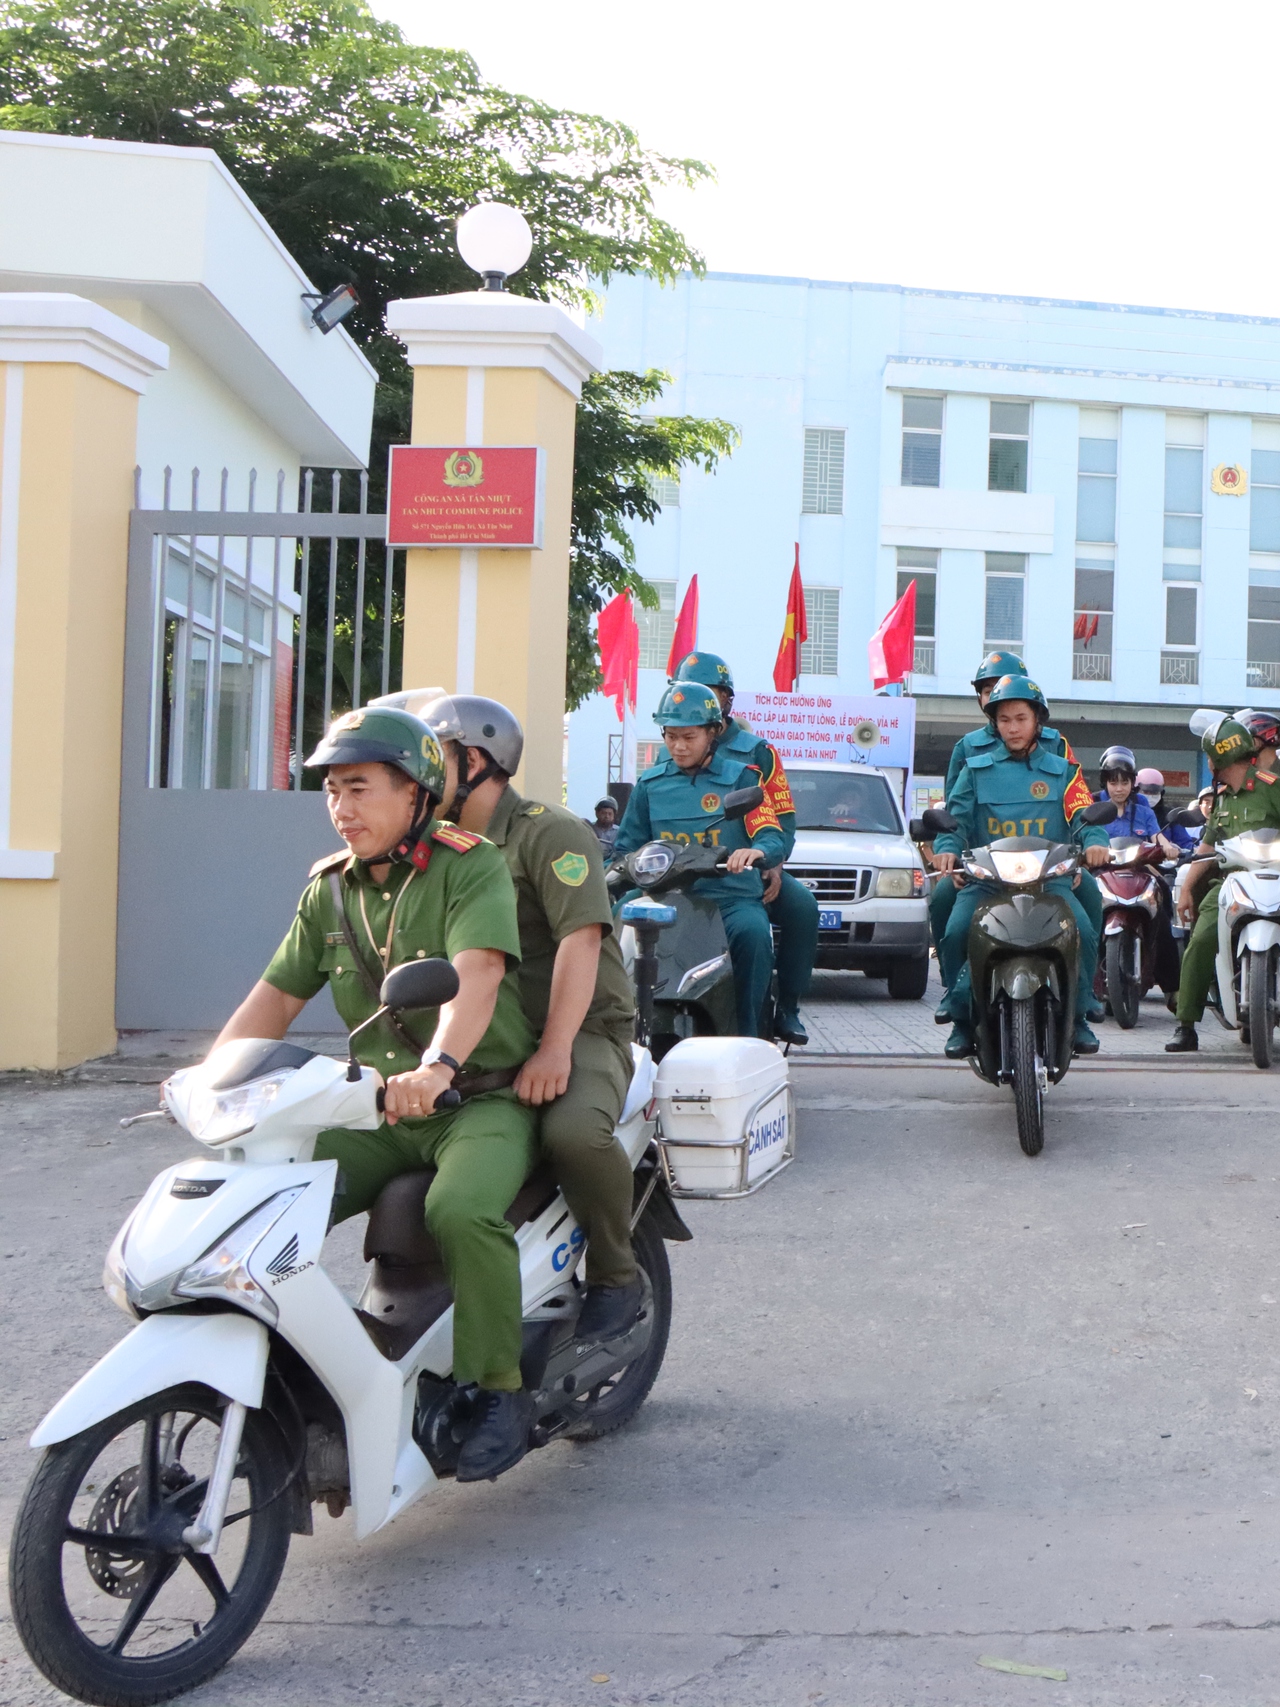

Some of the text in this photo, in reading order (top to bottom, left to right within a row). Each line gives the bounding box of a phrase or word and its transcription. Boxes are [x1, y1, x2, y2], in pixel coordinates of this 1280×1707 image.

[414, 493, 439, 503] CÔNG
[454, 494, 466, 502] XÃ
[755, 693, 771, 705] TÍCH
[773, 696, 788, 708] CỰC
[749, 710, 762, 722] TÁC
[778, 714, 788, 725] LẠI
[790, 712, 805, 726] TRẬT
[767, 728, 785, 740] TOÀN
[787, 731, 805, 741] GIAO
[793, 747, 802, 758] XÃ
[805, 746, 817, 758] TÂN
[1215, 734, 1242, 755] CSTT
[988, 817, 1047, 837] DQTT
[749, 1109, 785, 1156] CẢNH SÁT
[173, 1184, 208, 1193] HONDA
[271, 1260, 315, 1287] HONDA
